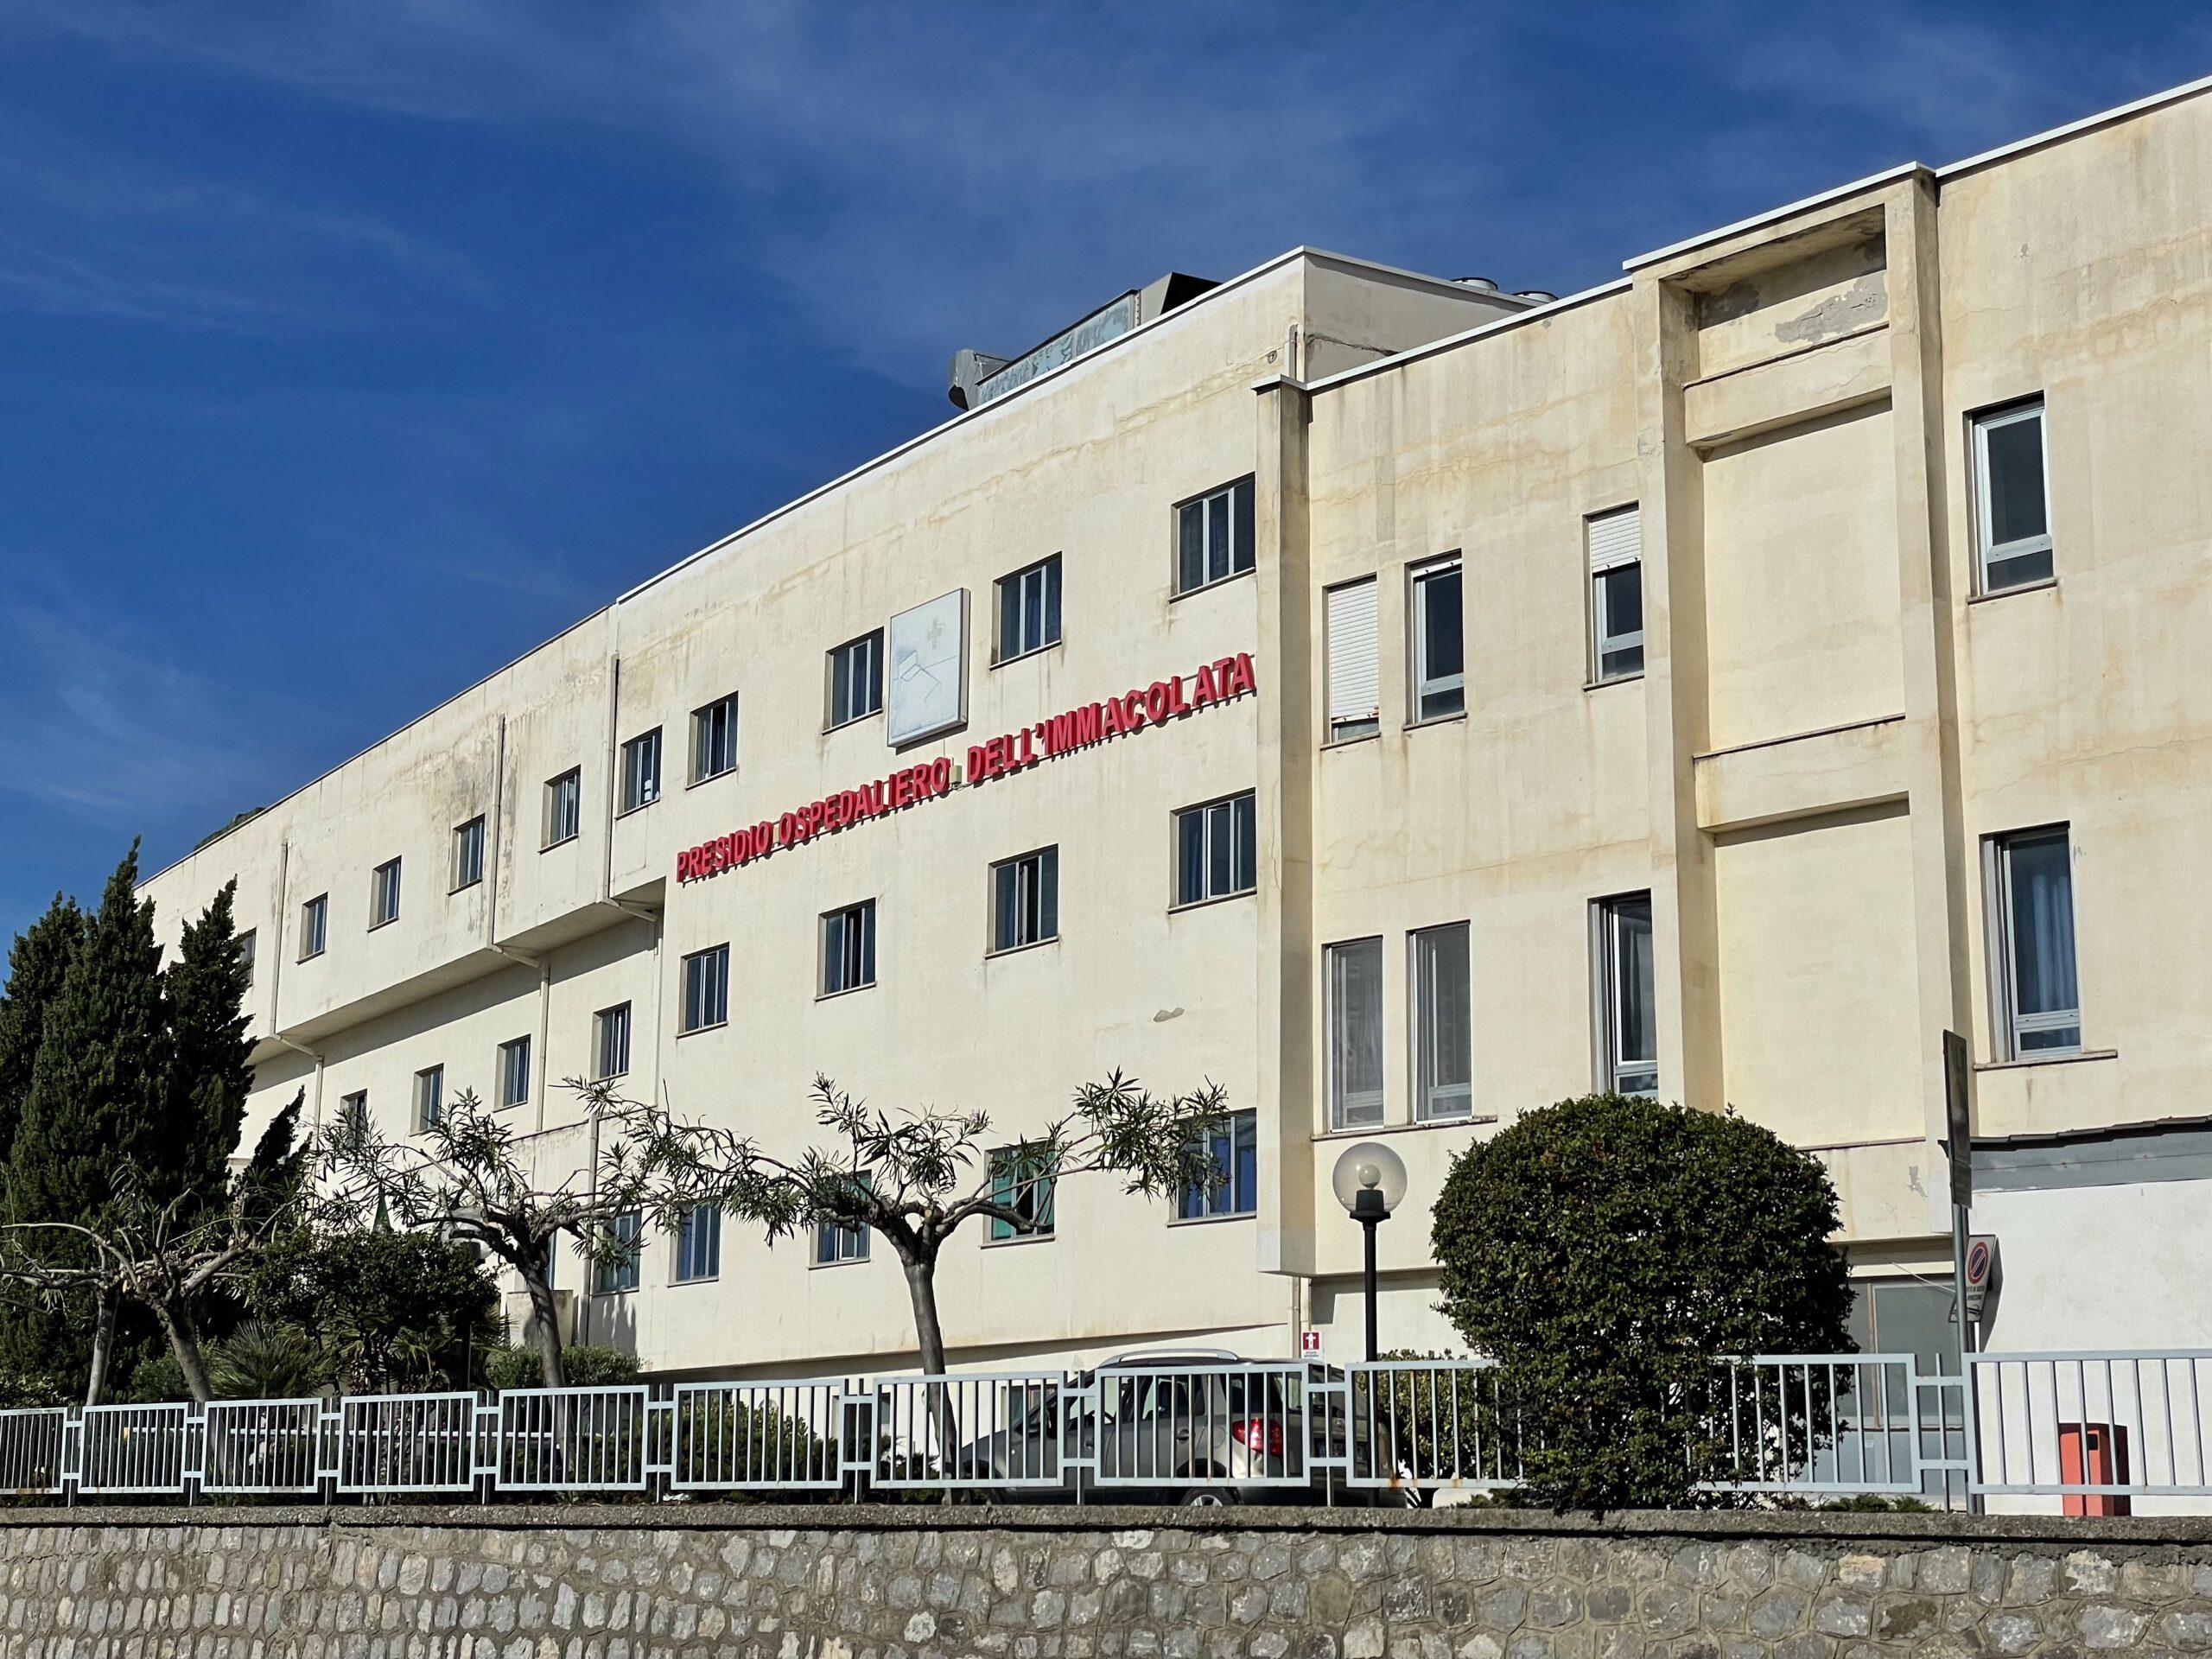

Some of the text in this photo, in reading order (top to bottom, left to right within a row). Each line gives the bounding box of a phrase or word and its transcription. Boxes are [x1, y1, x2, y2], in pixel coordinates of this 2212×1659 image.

[677, 652, 1255, 882] PRESIDIO OSPEDALIERO DELL'IMMACOLATA
